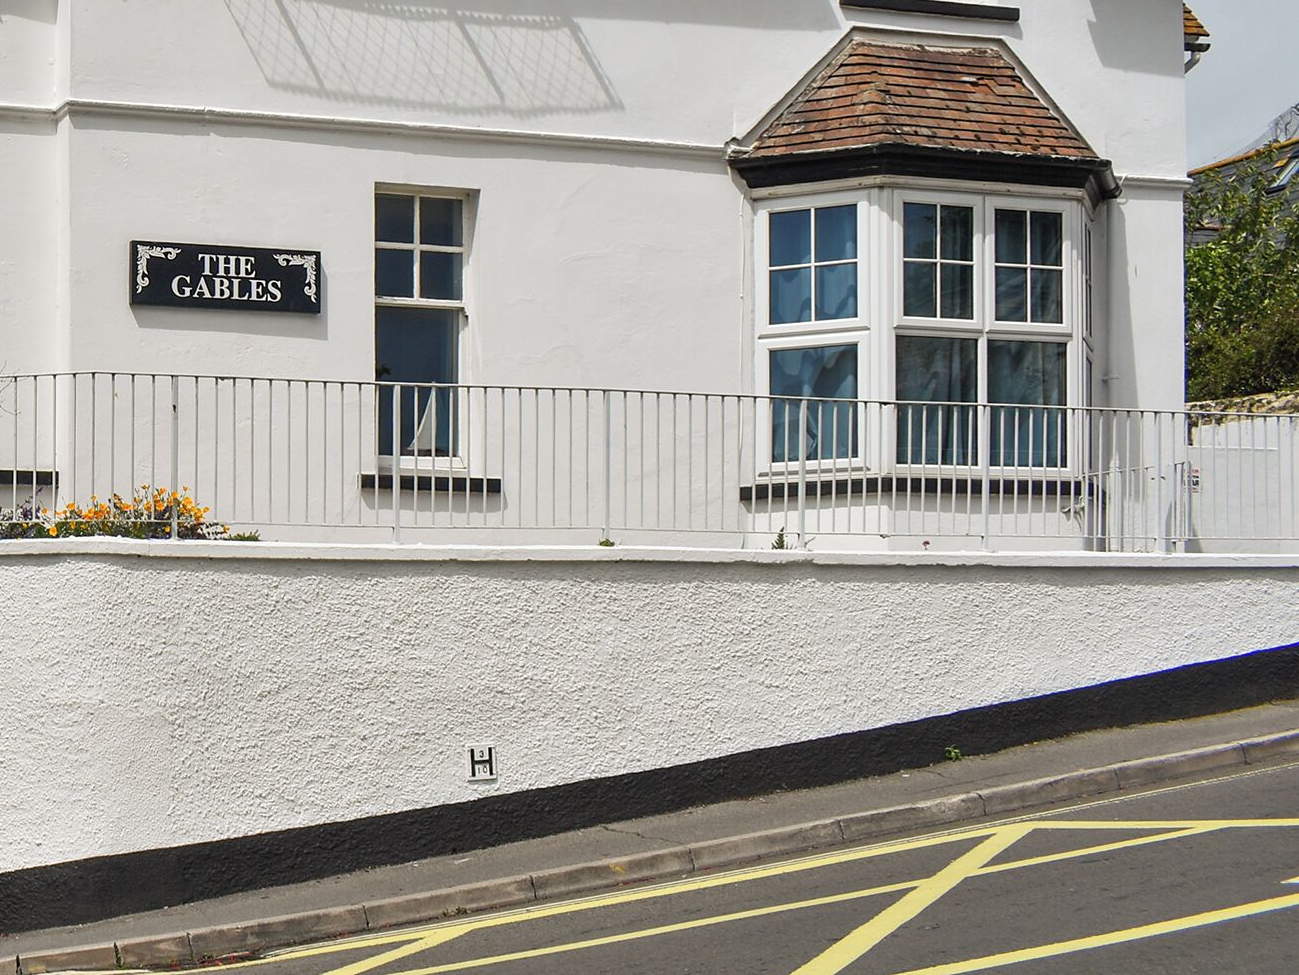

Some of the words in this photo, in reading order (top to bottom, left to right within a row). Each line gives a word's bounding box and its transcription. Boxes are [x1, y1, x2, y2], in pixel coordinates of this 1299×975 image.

[198, 253, 256, 279] THE
[171, 275, 282, 303] GABLES
[470, 747, 494, 777] H
[478, 750, 485, 759] 3
